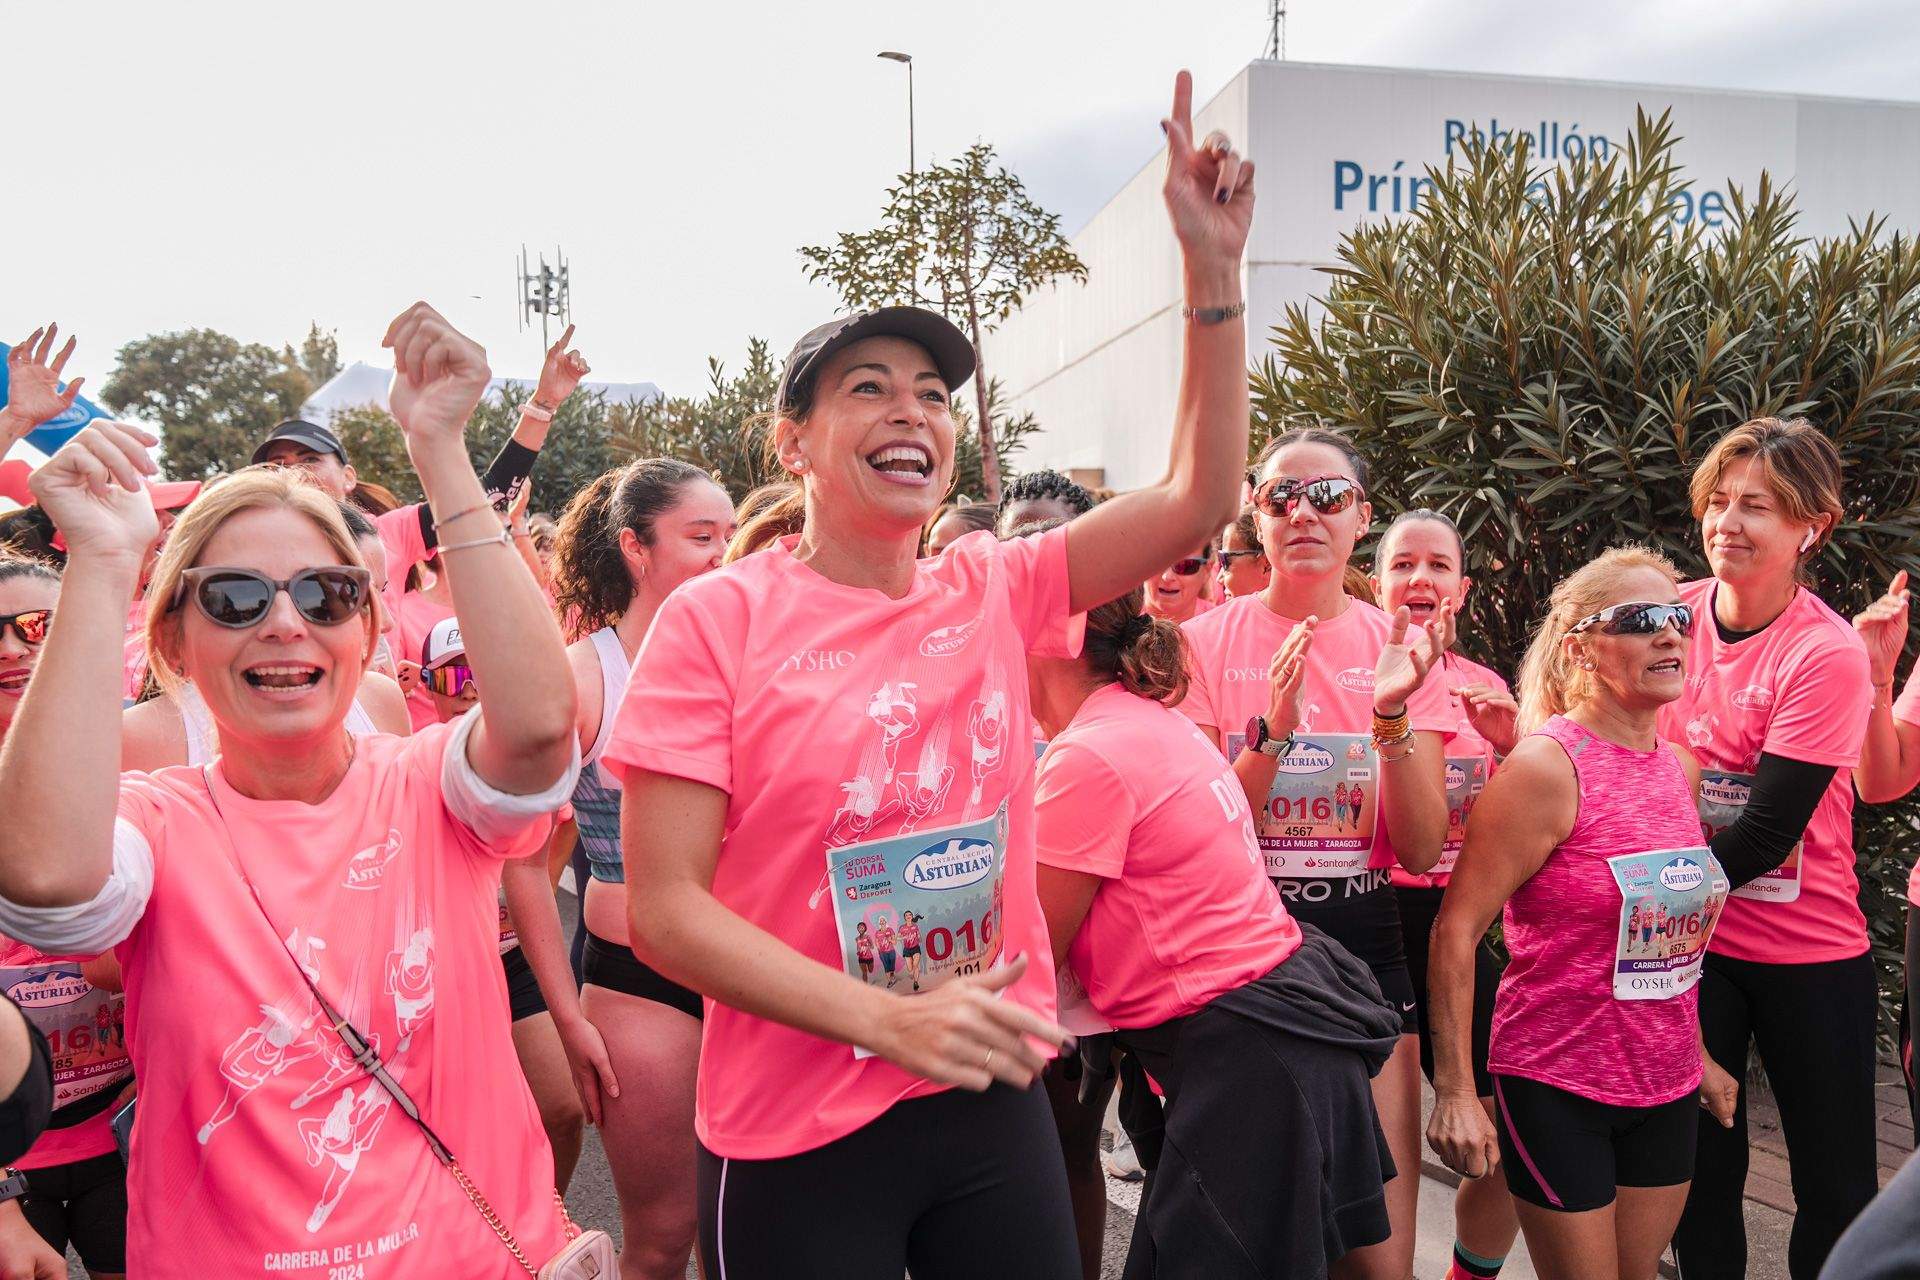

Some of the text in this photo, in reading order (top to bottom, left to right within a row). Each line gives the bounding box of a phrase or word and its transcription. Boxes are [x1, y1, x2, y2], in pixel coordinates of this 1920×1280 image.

[784, 649, 857, 671] YSHO
[1225, 668, 1271, 682] OYSH
[1279, 757, 1330, 767] STURIANA
[1445, 775, 1464, 784] RIANA
[1700, 782, 1748, 800] ASTURIAN
[1270, 796, 1331, 820] 016
[1285, 826, 1314, 838] 4567
[1271, 839, 1281, 847] DE
[1282, 839, 1292, 847] LA
[1294, 839, 1319, 848] MUJER
[1325, 839, 1362, 848] ZARAGOZA
[846, 862, 886, 880] SUMA
[911, 853, 992, 883] ASTURIANA
[859, 880, 892, 892] Zaragoza
[1664, 871, 1702, 885] ASTURIANA
[1277, 880, 1332, 902] RO
[1665, 912, 1700, 939] 016
[925, 910, 992, 961] 016
[1632, 959, 1665, 969] CARRERA
[13, 983, 89, 1002] ASTURIANA
[47, 1025, 91, 1053] 16
[53, 1057, 130, 1081] UJER ZARAGOZA
[264, 1249, 330, 1271] CARRERA
[333, 1245, 354, 1263] DE
[356, 1240, 375, 1258] LA
